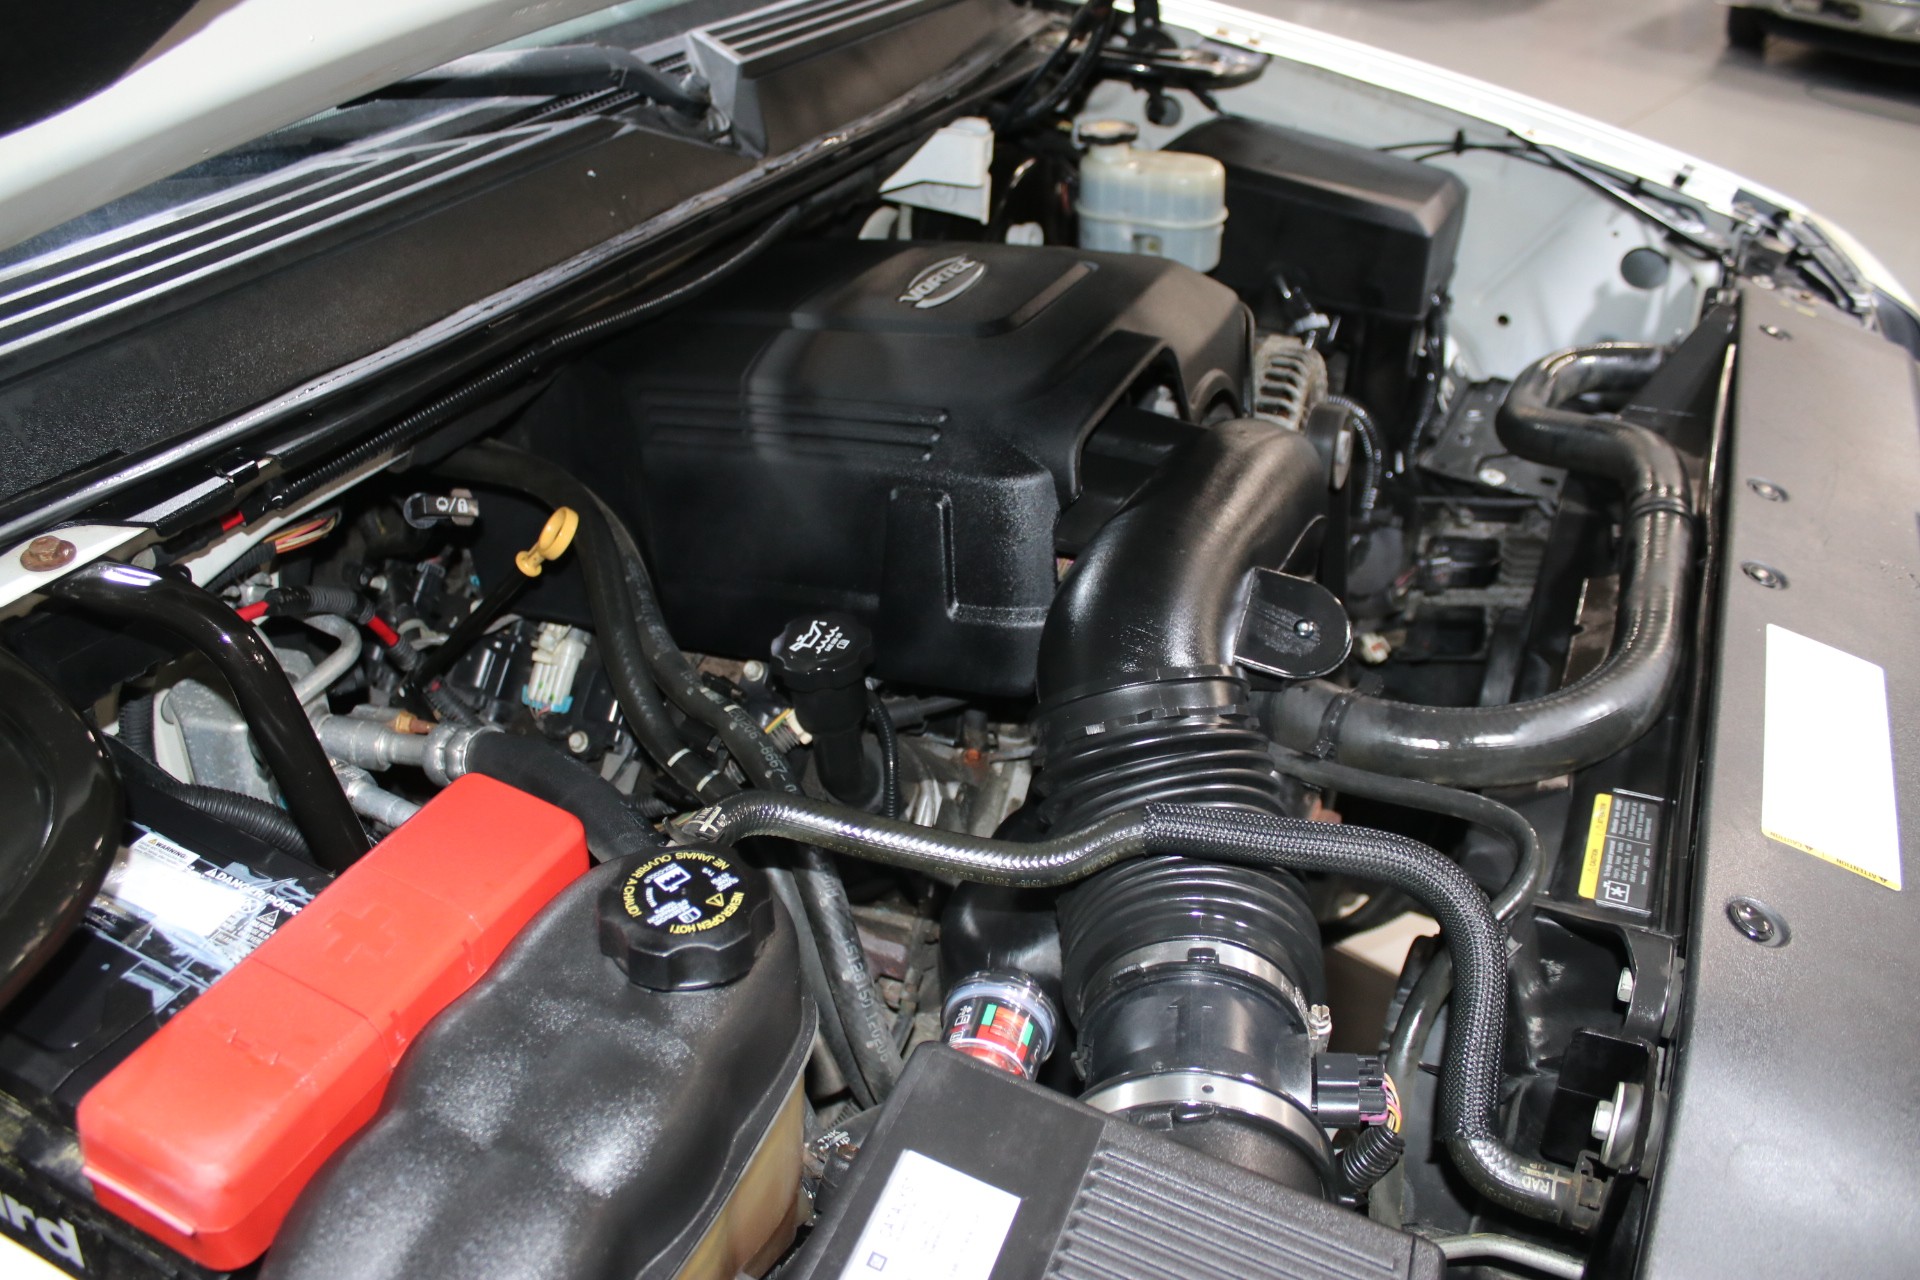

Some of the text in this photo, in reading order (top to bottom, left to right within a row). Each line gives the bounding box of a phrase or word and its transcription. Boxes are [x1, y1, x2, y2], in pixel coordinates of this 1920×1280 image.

[899, 258, 976, 302] VORTEC
[155, 841, 188, 859] WARNING:
[674, 852, 716, 863] JAMAIS
[631, 854, 672, 879] OUVRIR
[712, 858, 730, 870] NE
[1836, 858, 1877, 879] ATTENTION
[626, 877, 638, 885] A
[669, 891, 745, 935] NEVER OPEN HOT!
[1521, 1175, 1550, 1193] RAD
